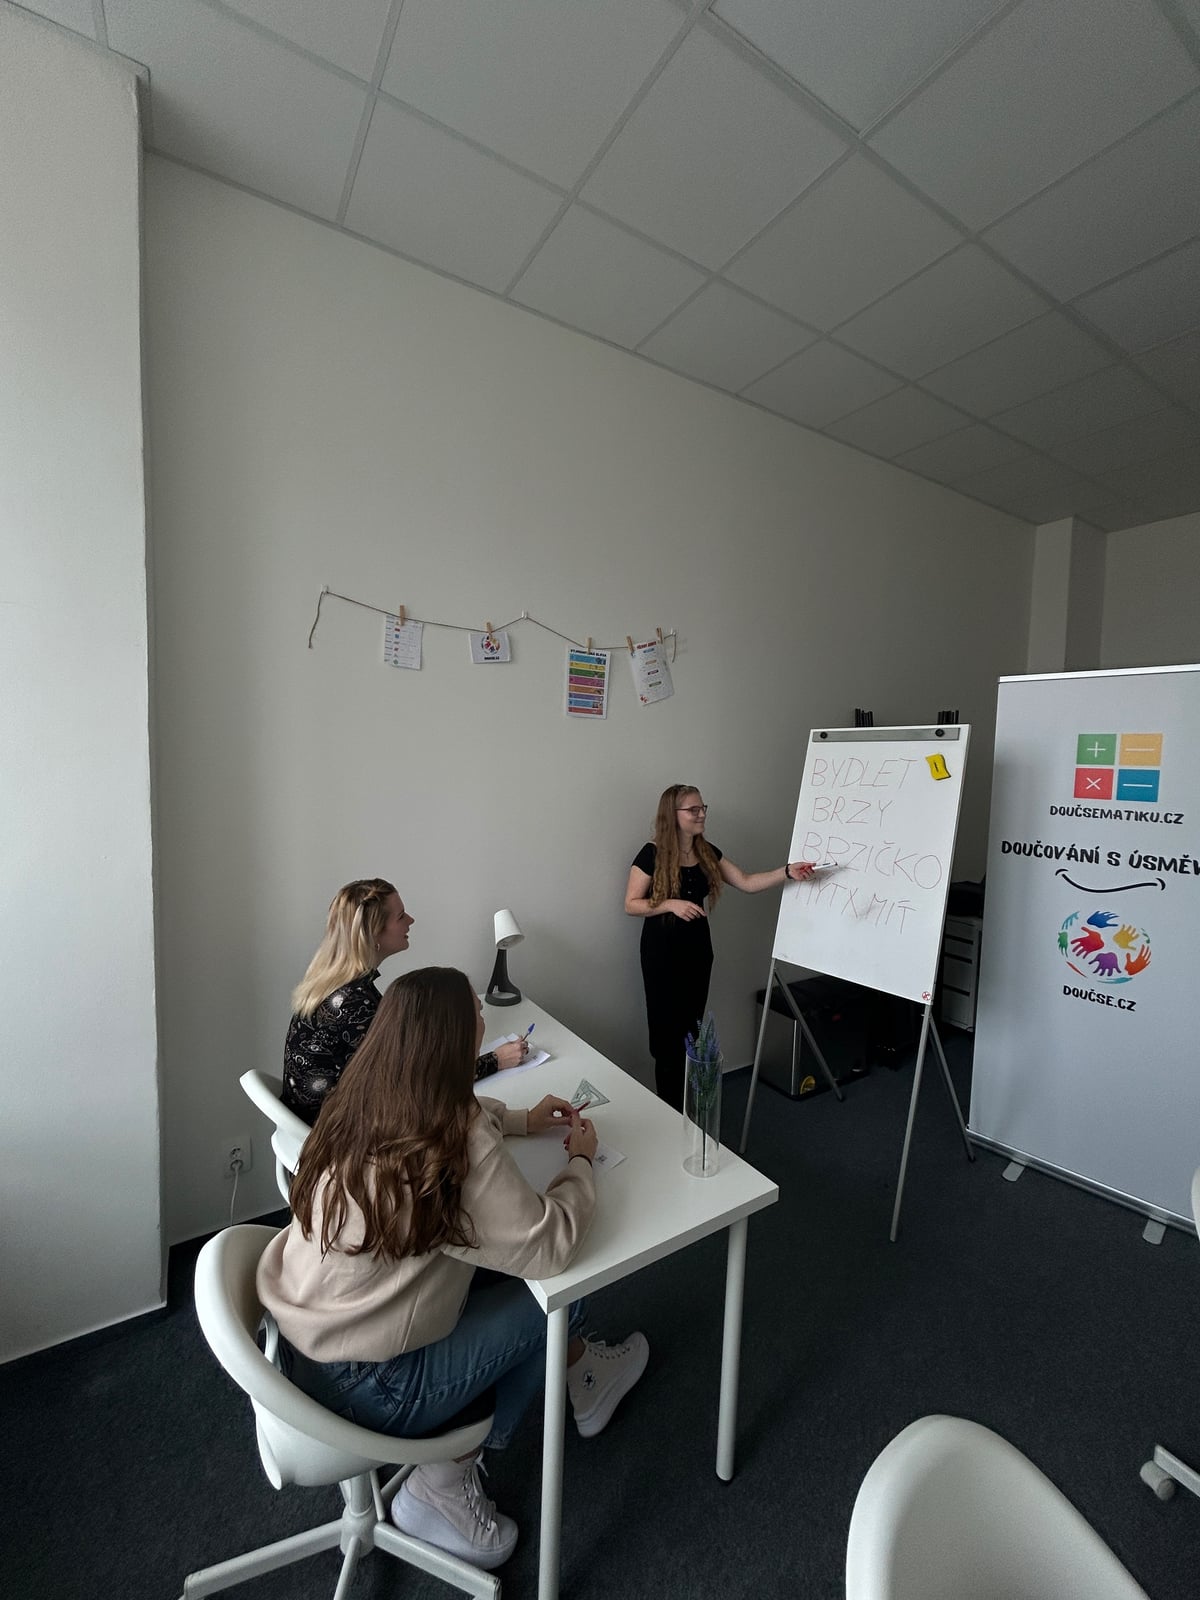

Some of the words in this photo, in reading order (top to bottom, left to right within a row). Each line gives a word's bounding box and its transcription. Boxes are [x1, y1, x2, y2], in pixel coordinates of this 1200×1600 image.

[810, 757, 918, 790] BYDLET
[810, 796, 893, 828] BRZY
[1049, 804, 1185, 825] DOUČSEMATIKU.CZ
[801, 831, 943, 890] BRZIČKO
[1000, 839, 1101, 866] DOUČOVÁNÍ
[1106, 850, 1122, 867] S
[840, 887, 859, 919] X
[1062, 984, 1138, 1013] DOUČSE.CZ
